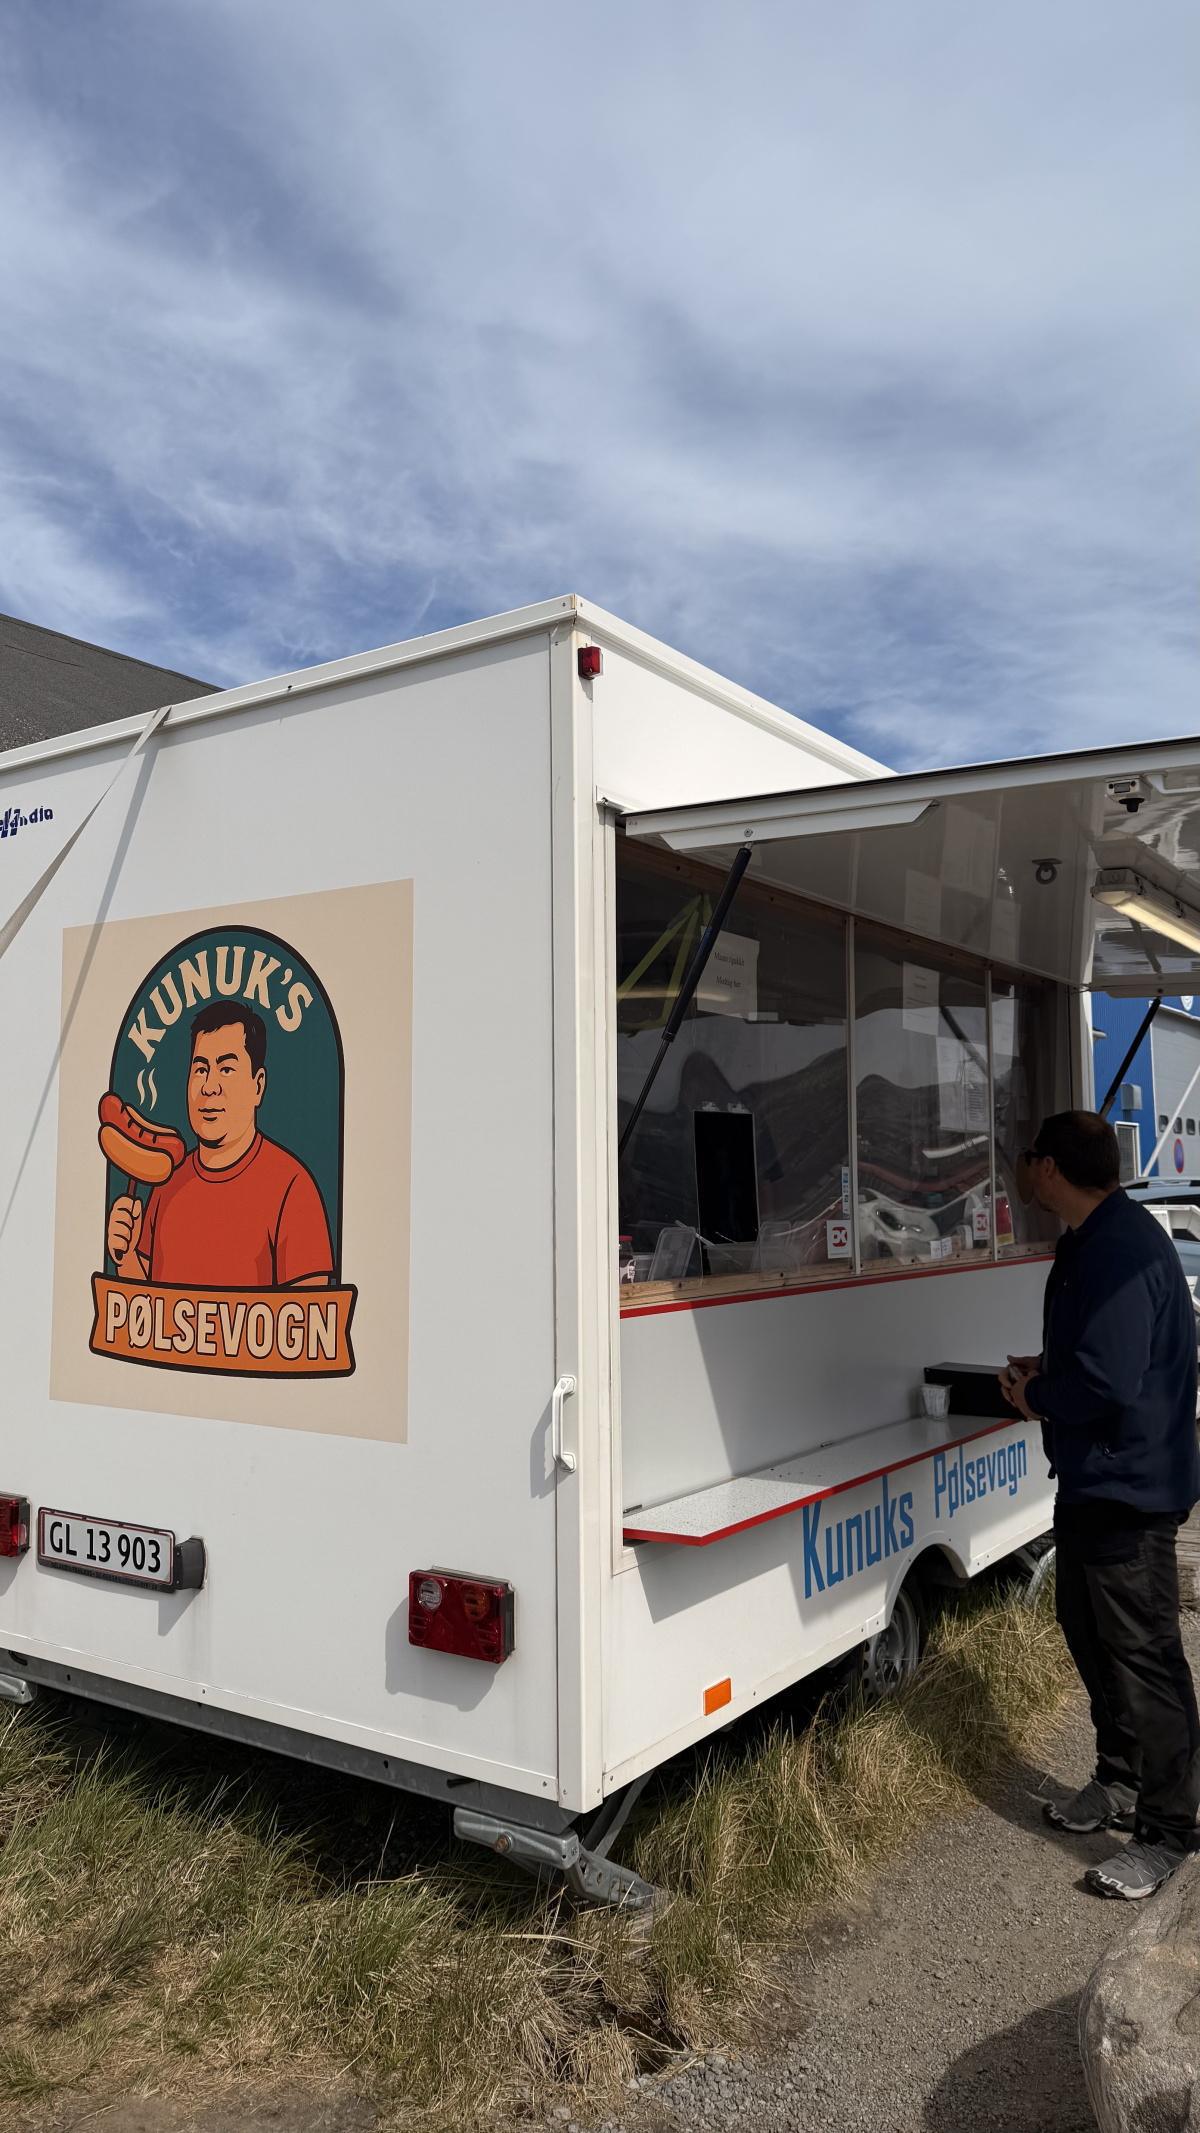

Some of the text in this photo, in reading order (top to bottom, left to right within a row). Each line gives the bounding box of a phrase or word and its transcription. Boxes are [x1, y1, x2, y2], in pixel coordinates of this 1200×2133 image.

[127, 945, 314, 1063] KUNUK'S
[104, 1290, 338, 1360] PØLSEVOGN
[50, 1521, 161, 1573] GL 13 903
[803, 1440, 1027, 1599] Kunuks Pølsevogn
